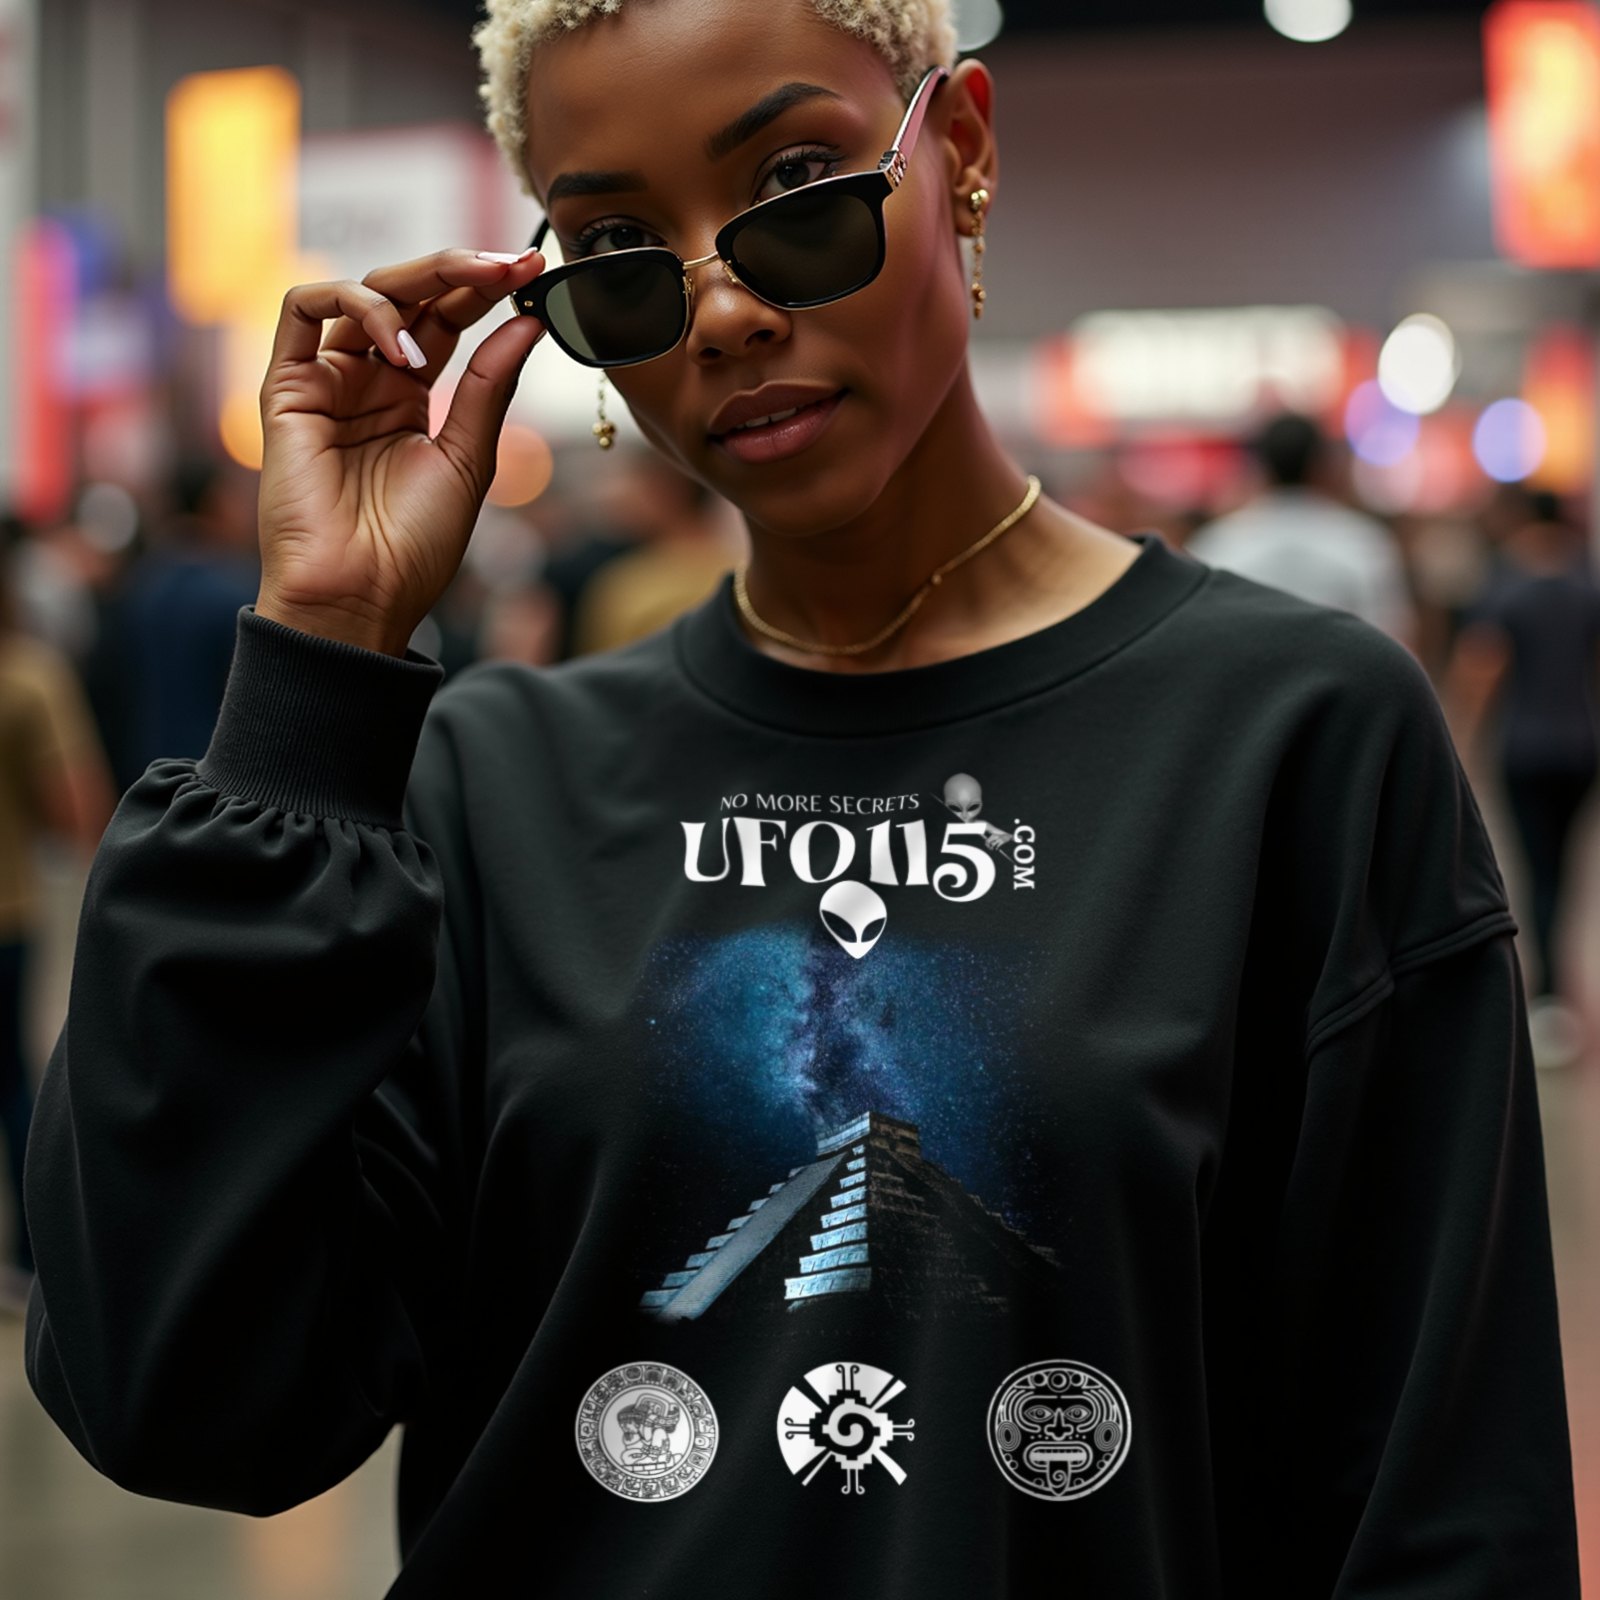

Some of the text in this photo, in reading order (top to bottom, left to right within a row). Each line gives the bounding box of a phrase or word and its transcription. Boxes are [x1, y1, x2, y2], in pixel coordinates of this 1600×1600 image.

[720, 793, 920, 815] NO MORE SECRETS
[680, 817, 996, 902] UFO115
[1013, 818, 1036, 890] .COM
